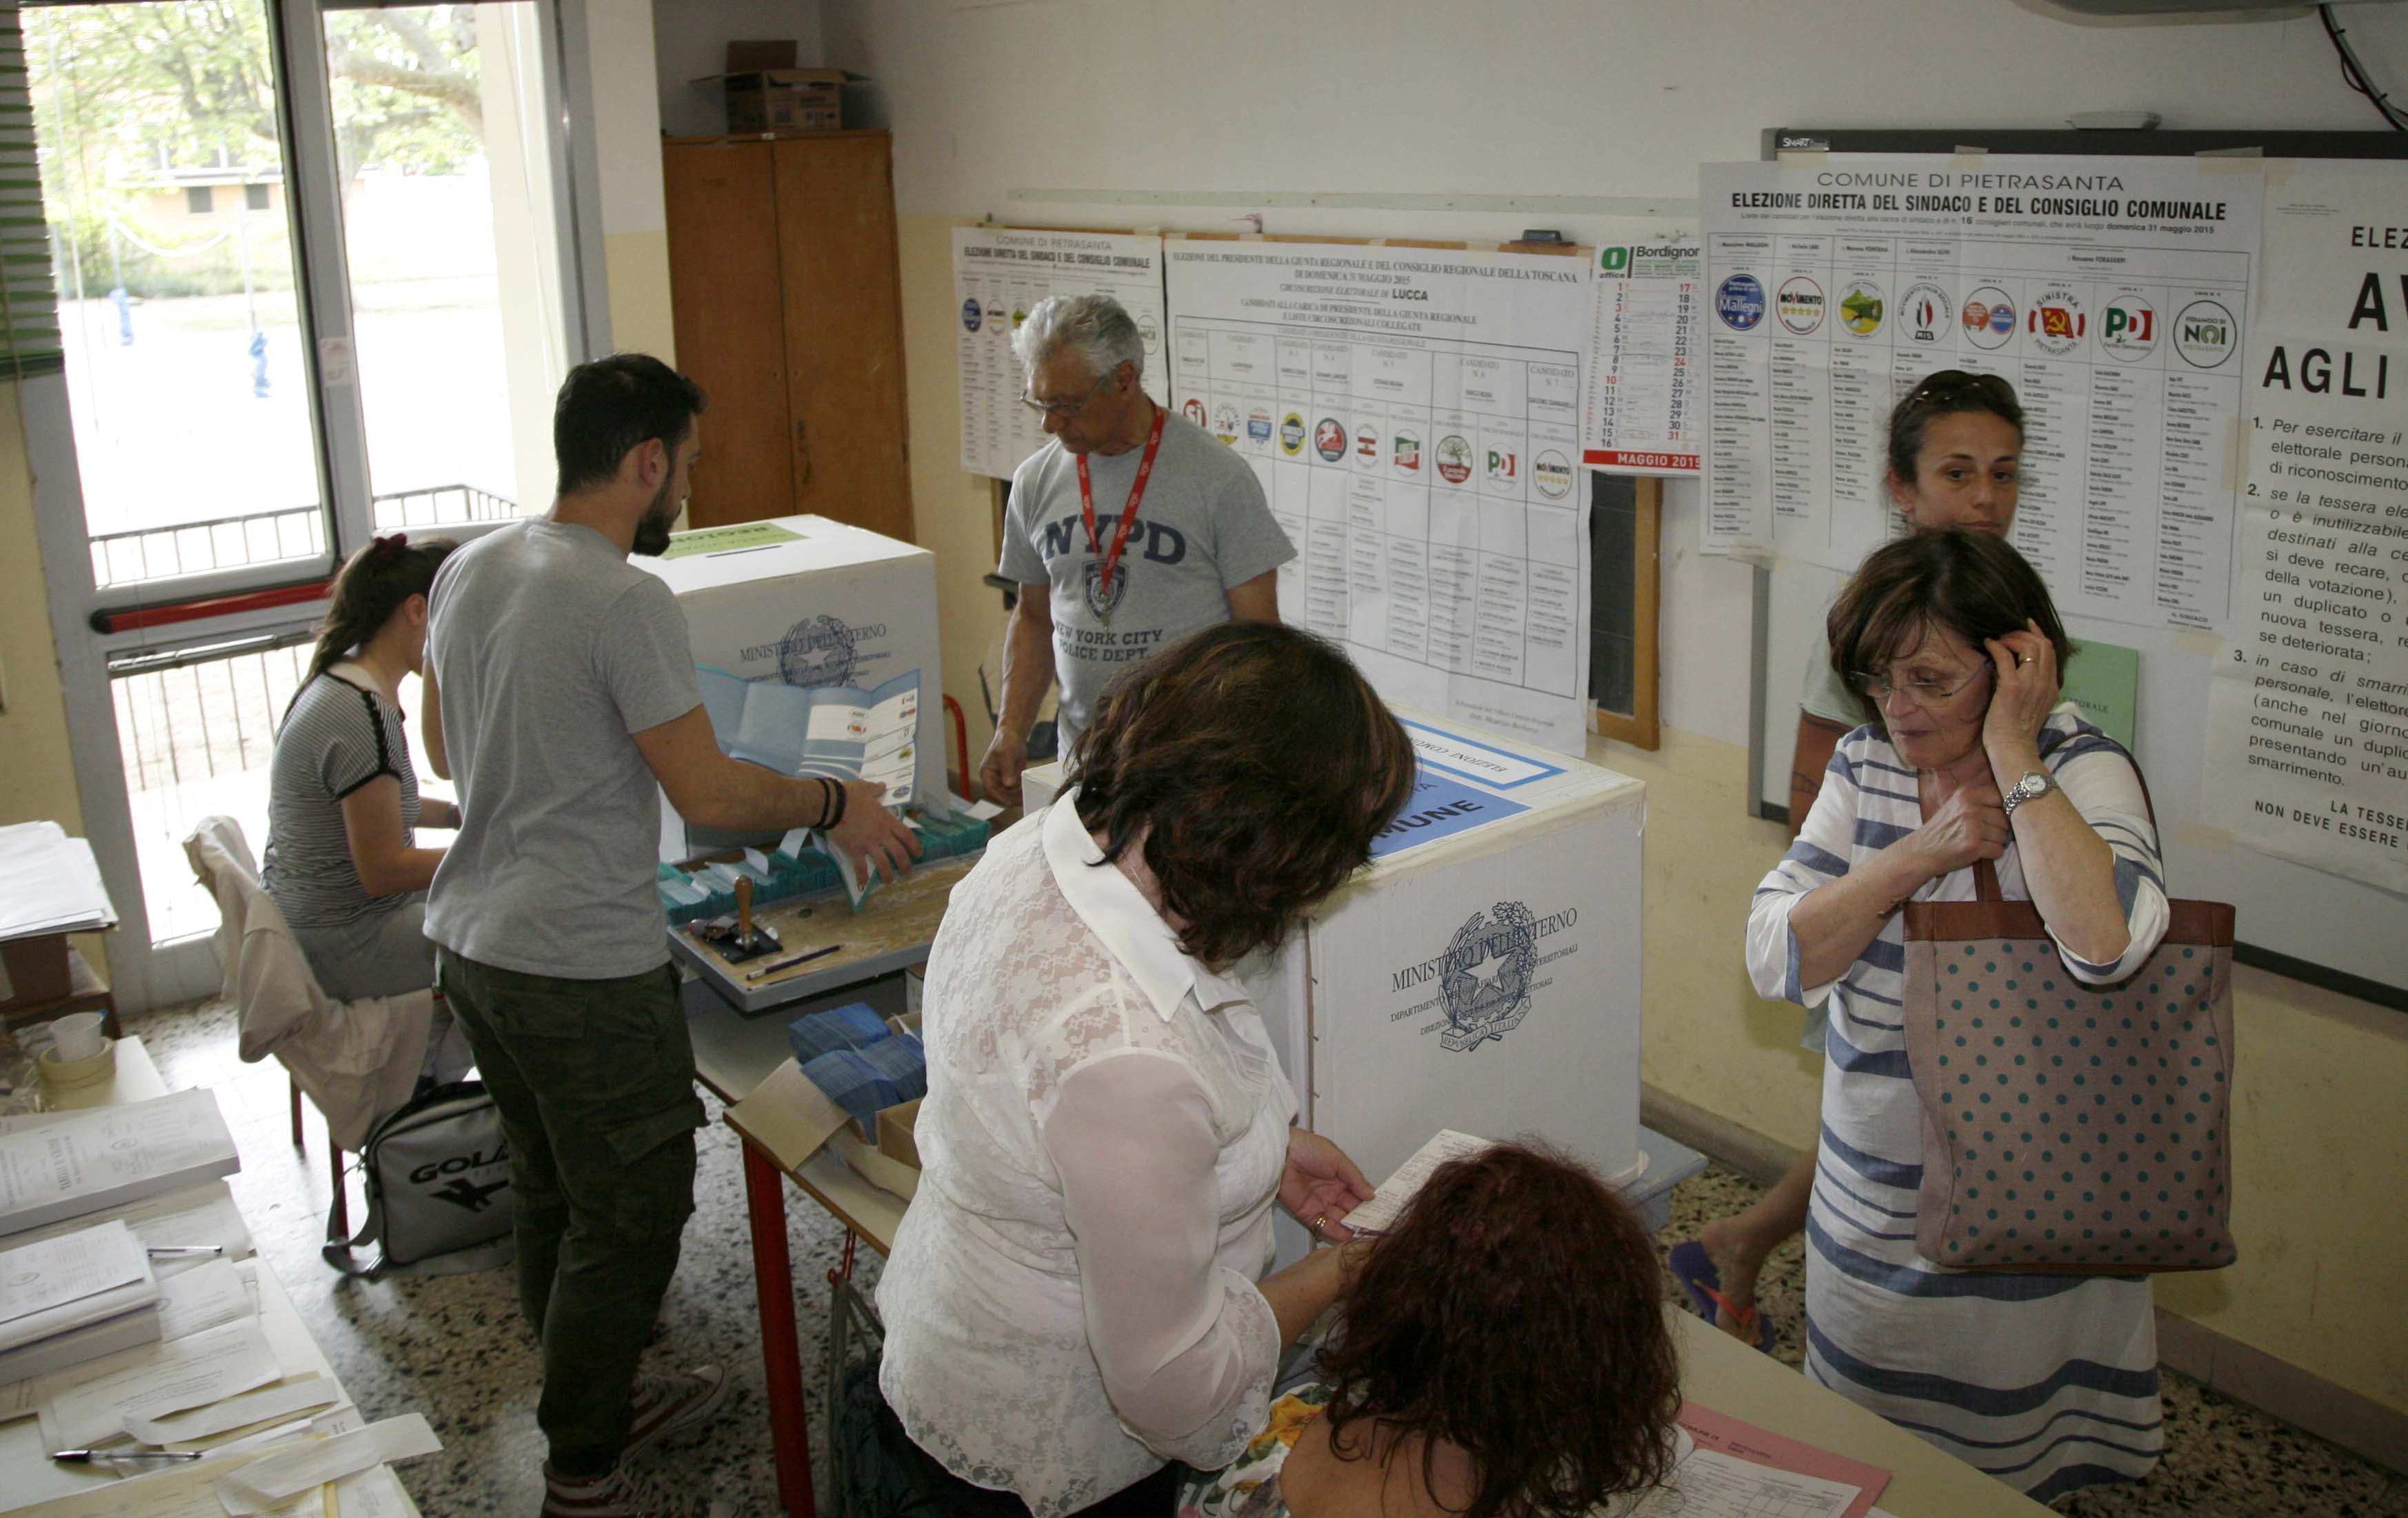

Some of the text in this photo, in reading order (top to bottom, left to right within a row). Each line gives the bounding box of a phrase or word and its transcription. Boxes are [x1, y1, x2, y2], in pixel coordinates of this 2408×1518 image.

[1783, 138, 1809, 148] SMART
[1817, 172, 2125, 192] COMUNE DI PIETRASANTA
[1732, 192, 2226, 221] ELEZIONE DIRETTA DEL SINDACO E DEL CONSIGLIO COMUNALE
[1961, 216, 1973, 225] 16
[2106, 223, 2146, 232] domenica
[2160, 225, 2191, 234] maggio
[2194, 225, 2214, 234] 2015
[1173, 252, 1577, 283] ELEZIONE DEL PRESIDENTE DELLA GIUNTA REGIONALE E DEL CONSIGLIO REGIONALE DELLA TOSCANA
[1305, 270, 1347, 279] DOMENICA
[1394, 275, 1412, 284] 2015
[1392, 288, 1428, 301] LUCCA
[1680, 283, 1690, 292] 17
[1616, 293, 1623, 302] 2
[1679, 294, 1689, 303] 18
[1780, 291, 1822, 305] MOVIMENTO
[2036, 291, 2079, 309] SINISTRA
[2347, 272, 2408, 332] A
[1616, 303, 1622, 312] 3
[1678, 305, 1689, 314] 19
[1719, 297, 1763, 314] Mallegni
[1614, 314, 1621, 322] 4
[1676, 315, 1688, 324] 20
[1614, 324, 1621, 333] 5
[1676, 326, 1687, 335] 21
[2184, 325, 2227, 345] NOI
[1614, 334, 1620, 343] 6
[1675, 336, 1687, 345] 22
[1614, 345, 1619, 354] 7
[1675, 347, 1687, 356] 23
[1612, 356, 1618, 364] 8
[1674, 358, 1686, 367] 24
[1612, 365, 1617, 374] 9
[1674, 367, 1685, 377] 25
[2262, 345, 2388, 399] AGLI
[1606, 376, 1616, 385] 10
[1672, 378, 1684, 387] 26
[1605, 386, 1616, 395] 11
[1672, 389, 1683, 398] 27
[1605, 396, 1616, 405] 12
[1671, 400, 1683, 409] 28
[1605, 407, 1614, 416] 13
[1670, 410, 1682, 419] 29
[1603, 418, 1614, 427] 14
[1669, 421, 1680, 430] 30
[1603, 428, 1612, 437] 15
[1668, 431, 1679, 441] 31
[2253, 416, 2402, 445] 1. Per esercitare il
[1602, 438, 1612, 447] 16
[1617, 454, 1667, 466] MAGGIO
[2271, 443, 2408, 467] elettorale person
[2269, 461, 2408, 491] di riconoscimento
[2247, 484, 2260, 496] 2.
[2270, 489, 2288, 500] se
[2296, 491, 2310, 505] la
[2318, 496, 2377, 514] tessera
[2270, 510, 2408, 539] o è inutilizzabile
[1044, 514, 1186, 565] NYPD
[2268, 529, 2336, 550] destinati
[2348, 542, 2378, 557] alla
[2266, 551, 2389, 582] si deve recare,
[2265, 569, 2397, 605] della votazione),
[2263, 591, 2391, 623] un duplicato o
[2261, 611, 2307, 629] nuova
[1055, 620, 1163, 645] NEW YORK CITY
[1059, 639, 1149, 662] POLICE DEPT
[2260, 631, 2371, 663] se deteriorata;
[2234, 649, 2247, 662] 3.
[2256, 654, 2269, 667] in
[2280, 662, 2318, 678] caso
[2329, 670, 2345, 682] di
[2255, 676, 2334, 702] personale,
[2254, 694, 2308, 716] (anche
[2322, 710, 2346, 724] nel
[2251, 716, 2323, 740] comunale
[2334, 734, 2354, 746] un
[2249, 734, 2347, 766] presentando
[1449, 751, 1507, 773] ELEZIONI
[2248, 754, 2345, 786] smarrimento.
[1379, 799, 1485, 840] MUNE
[2331, 801, 2408, 831] LA TESSE
[2255, 800, 2398, 848] NON DEVE ESSERE
